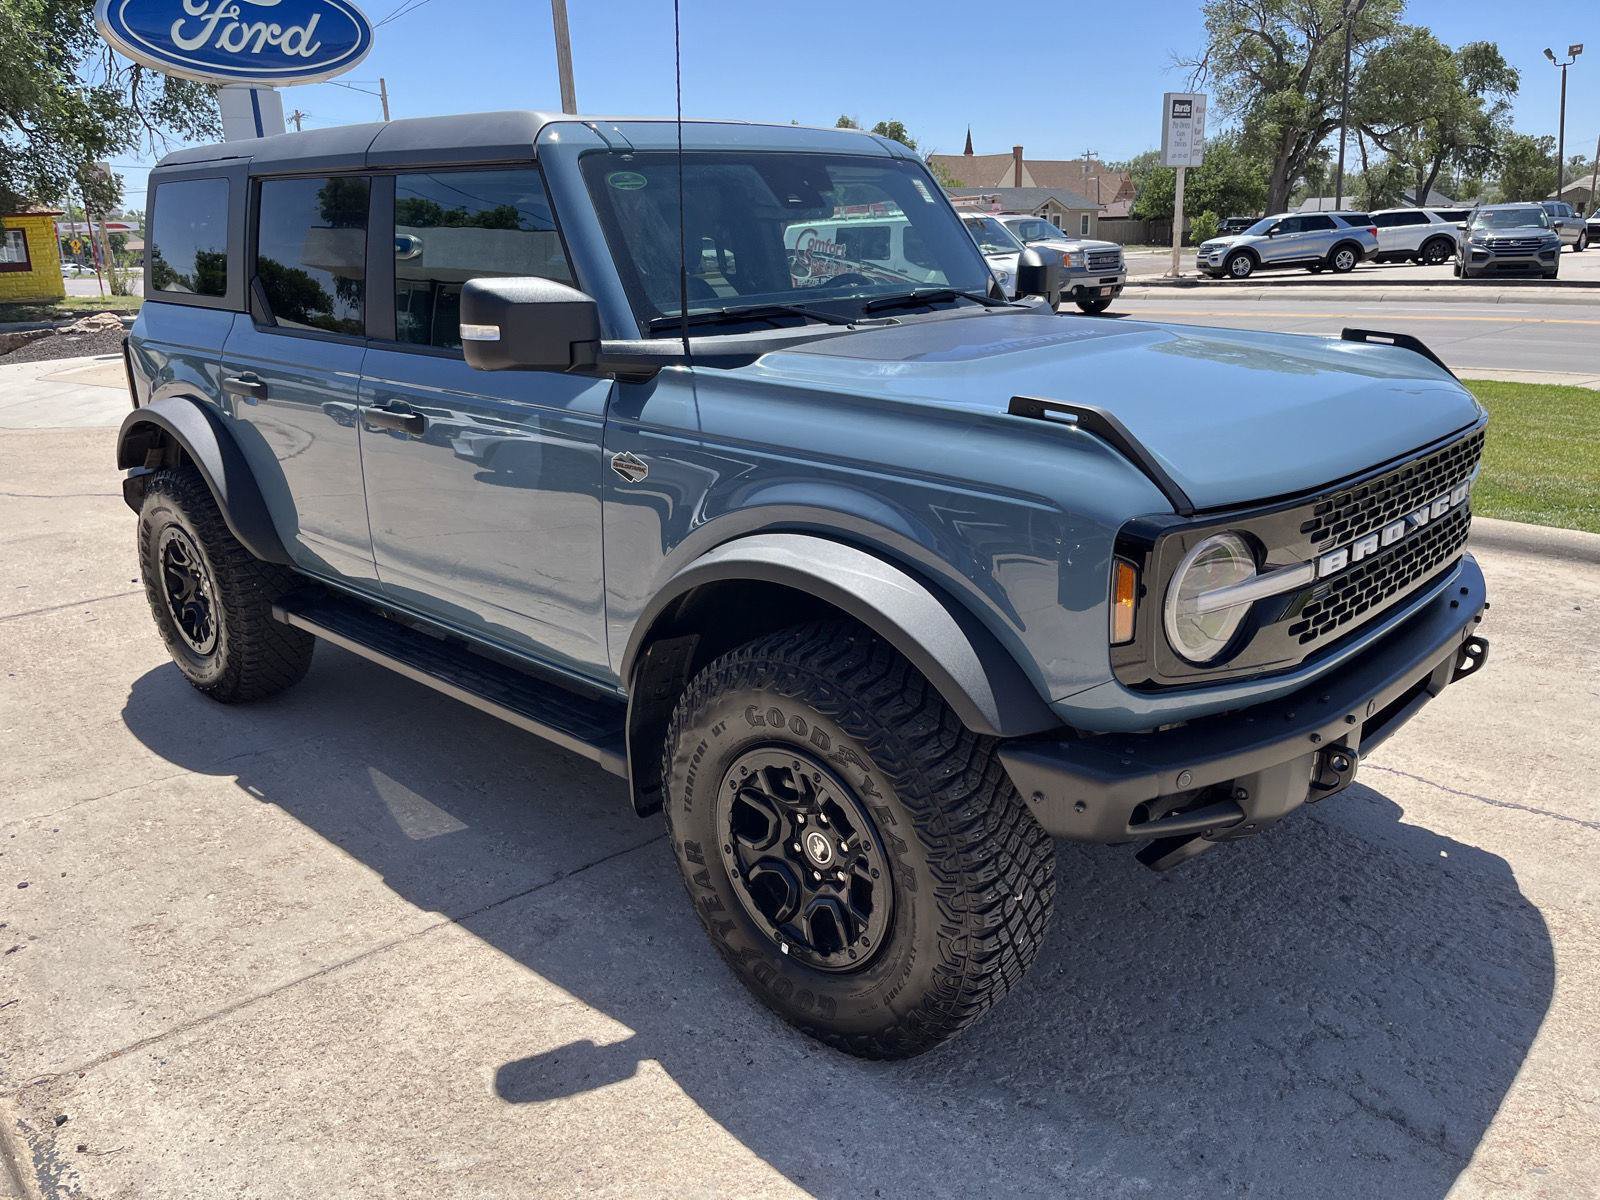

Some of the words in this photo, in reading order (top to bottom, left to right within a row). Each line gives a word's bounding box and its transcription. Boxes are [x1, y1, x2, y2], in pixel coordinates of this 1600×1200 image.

[171, 0, 321, 57] Ford
[1318, 480, 1470, 577] BRONCO
[683, 738, 709, 814] TERRITORY
